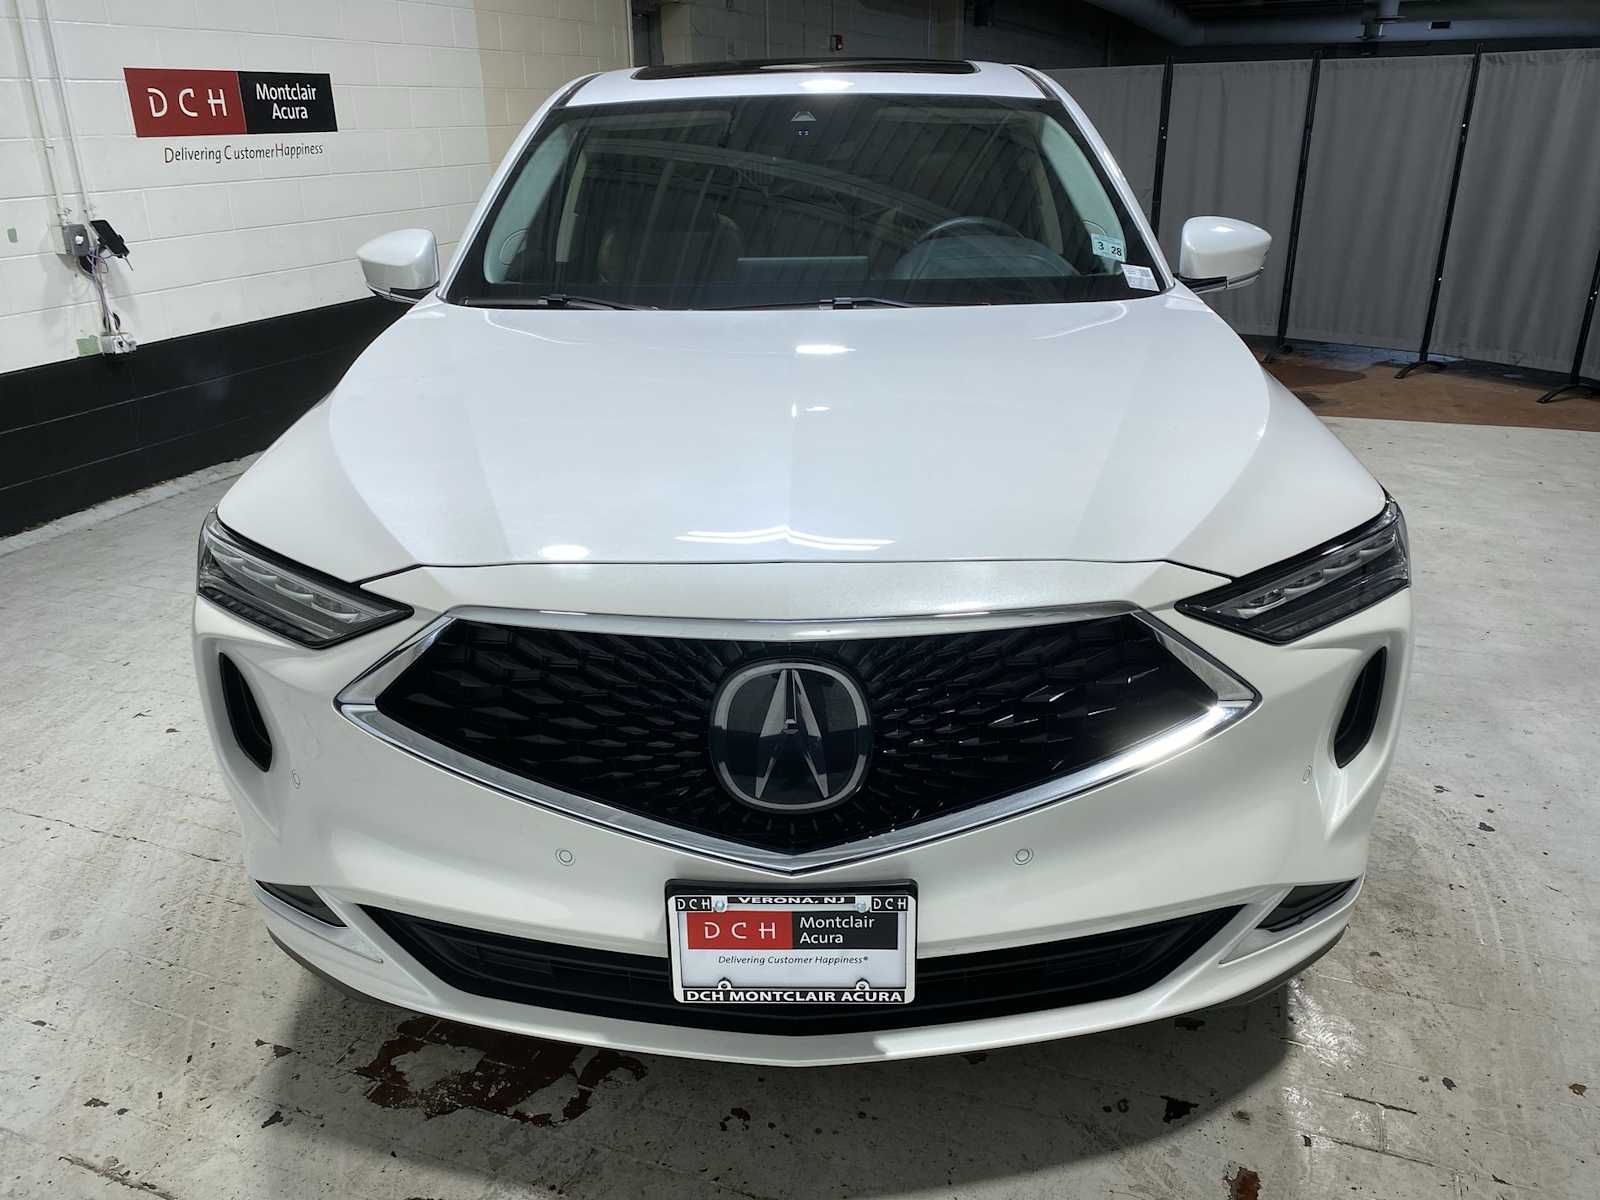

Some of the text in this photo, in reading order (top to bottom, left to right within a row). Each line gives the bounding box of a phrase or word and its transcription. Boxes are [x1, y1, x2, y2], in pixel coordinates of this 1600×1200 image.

[256, 83, 316, 101] Montclair
[272, 103, 308, 119] Acura
[164, 147, 222, 163] Delivering
[1097, 241, 1122, 257] 3 28
[677, 899, 711, 910] DCH
[823, 896, 846, 904] NJ
[873, 898, 907, 910] DCH
[799, 916, 875, 929] Montclair
[704, 922, 776, 940] DCH
[799, 932, 844, 944] Acura
[718, 955, 765, 966] Delivering
[768, 955, 813, 964] Customer
[686, 990, 902, 1001] DCH MONTCLAIR ACURA
